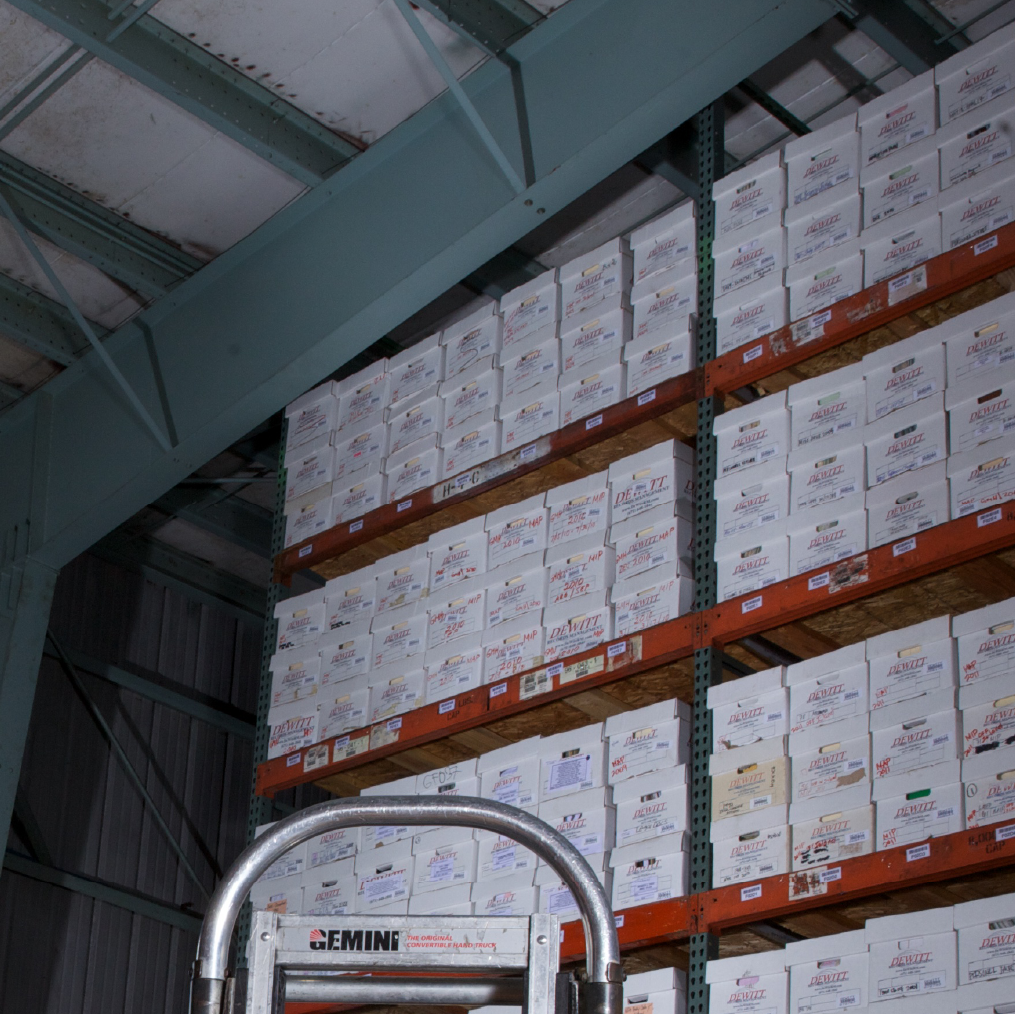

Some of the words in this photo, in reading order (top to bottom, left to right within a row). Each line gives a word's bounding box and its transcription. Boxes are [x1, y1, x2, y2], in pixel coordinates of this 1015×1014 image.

[549, 614, 601, 639] DEWITT
[888, 657, 928, 676] DEWITT
[807, 684, 845, 704] DEWITT
[729, 706, 765, 725] DEWITT
[273, 716, 314, 734] DEWITT
[891, 728, 933, 749] DEWITT
[809, 751, 848, 770] DEWITT
[729, 772, 765, 789] DEWITT
[633, 802, 667, 818] DEWITT
[895, 800, 937, 818] DEWITT
[812, 820, 850, 838] DEWITT
[731, 840, 767, 856] DEWITT
[309, 929, 399, 951] GEMINI
[889, 952, 933, 968] DEWITT
[809, 970, 850, 986] DEWITT
[727, 989, 767, 1004] DEWITT
